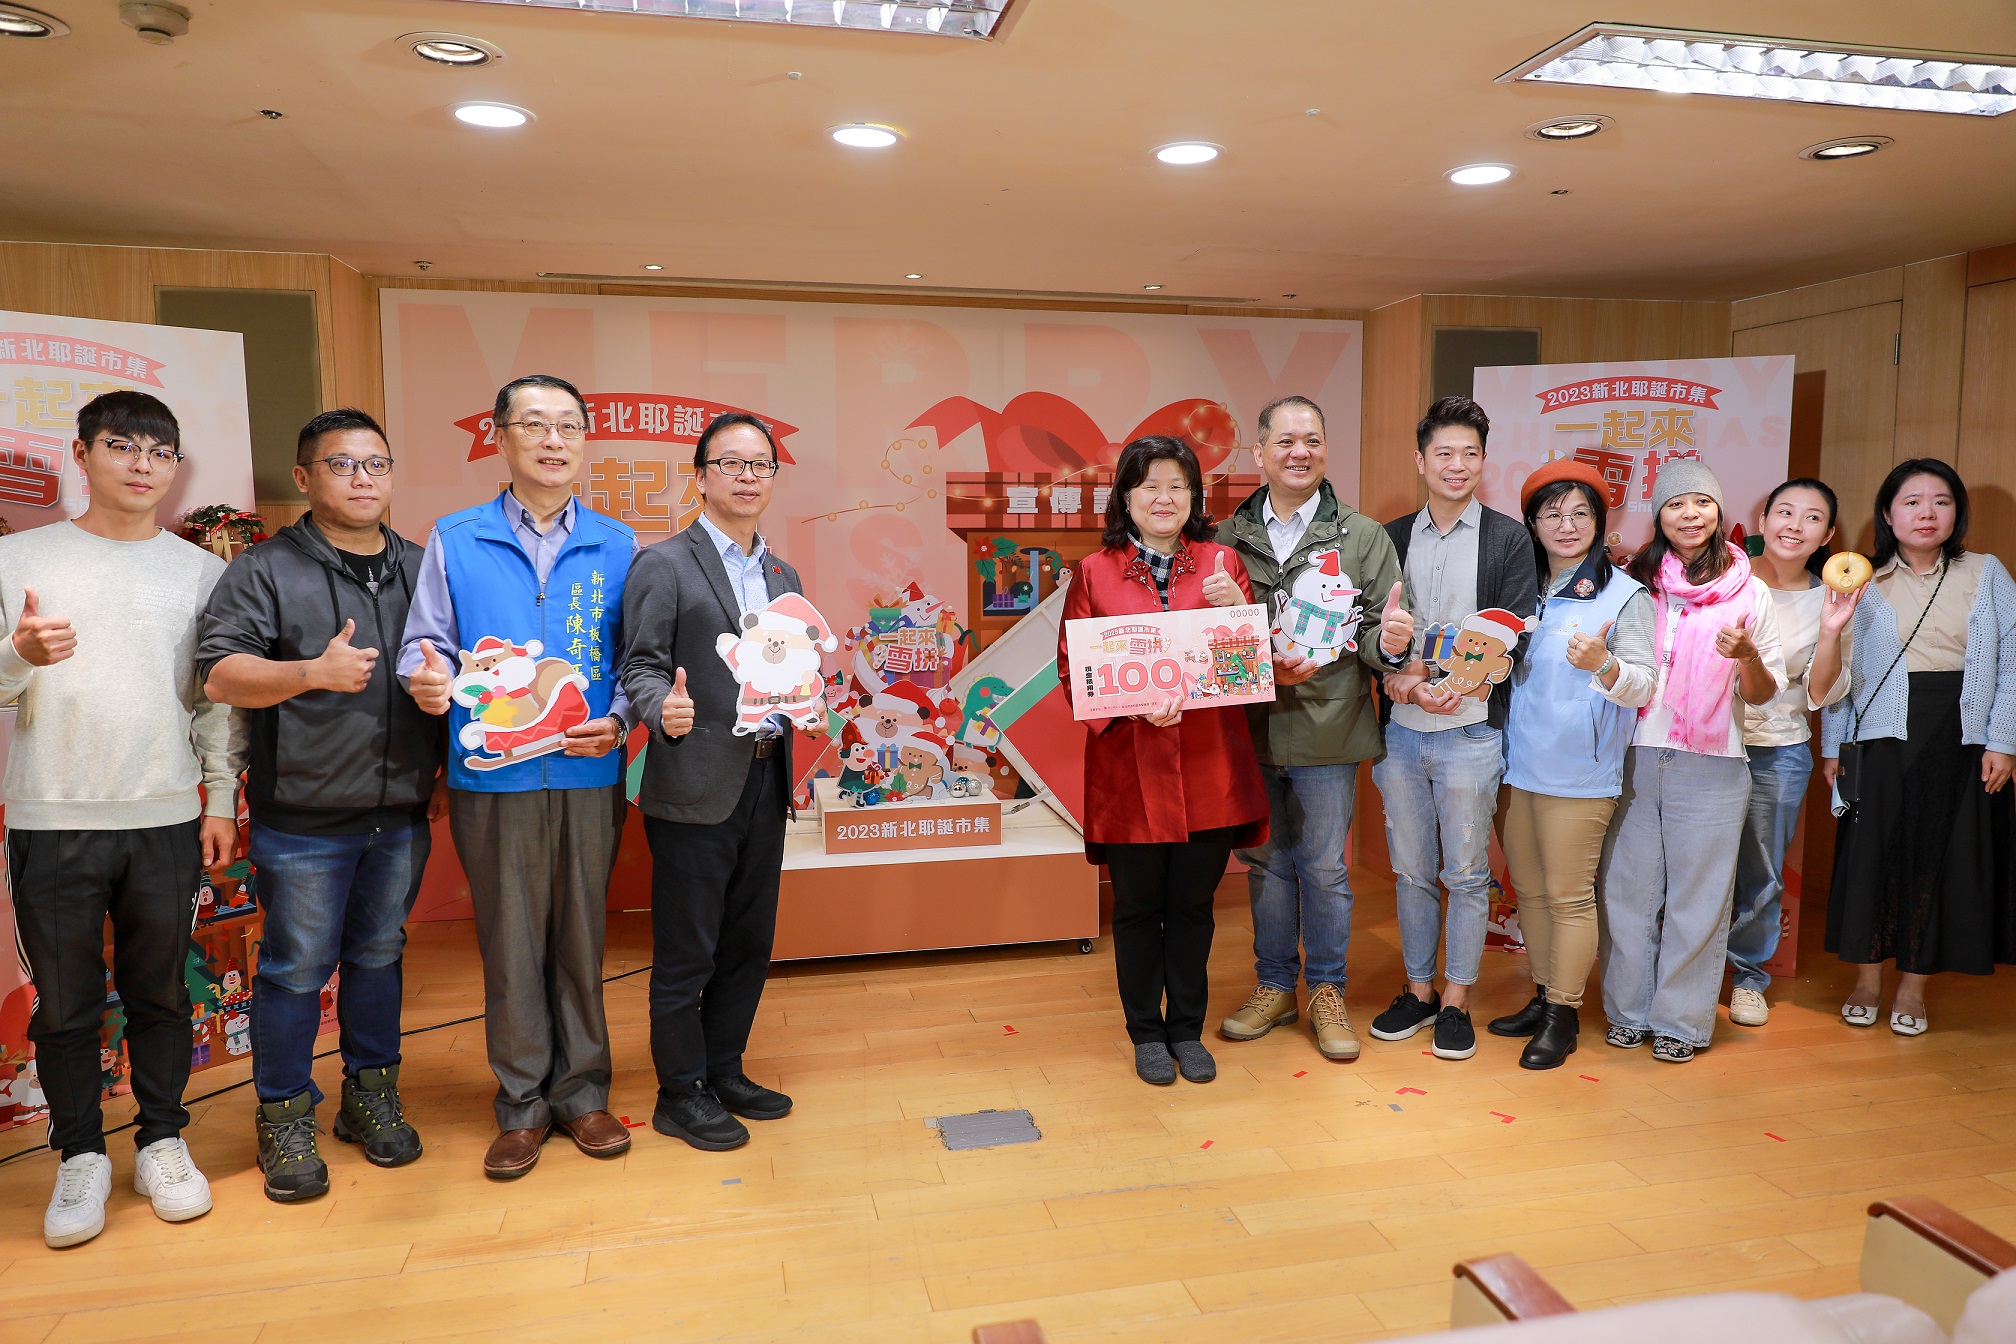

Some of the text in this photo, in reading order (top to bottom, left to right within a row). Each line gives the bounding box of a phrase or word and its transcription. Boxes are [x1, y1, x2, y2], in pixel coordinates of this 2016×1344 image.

[1547, 380, 1709, 407] 2023新北耶誕市集
[1554, 407, 1695, 449] 一起來
[589, 569, 606, 681] 新北市板橋區
[1230, 608, 1260, 619] 00000
[879, 628, 936, 646] 一起來
[887, 645, 939, 673] 雪拼
[1097, 658, 1183, 698] 100
[837, 816, 990, 840] 2023新北耶誕市集
